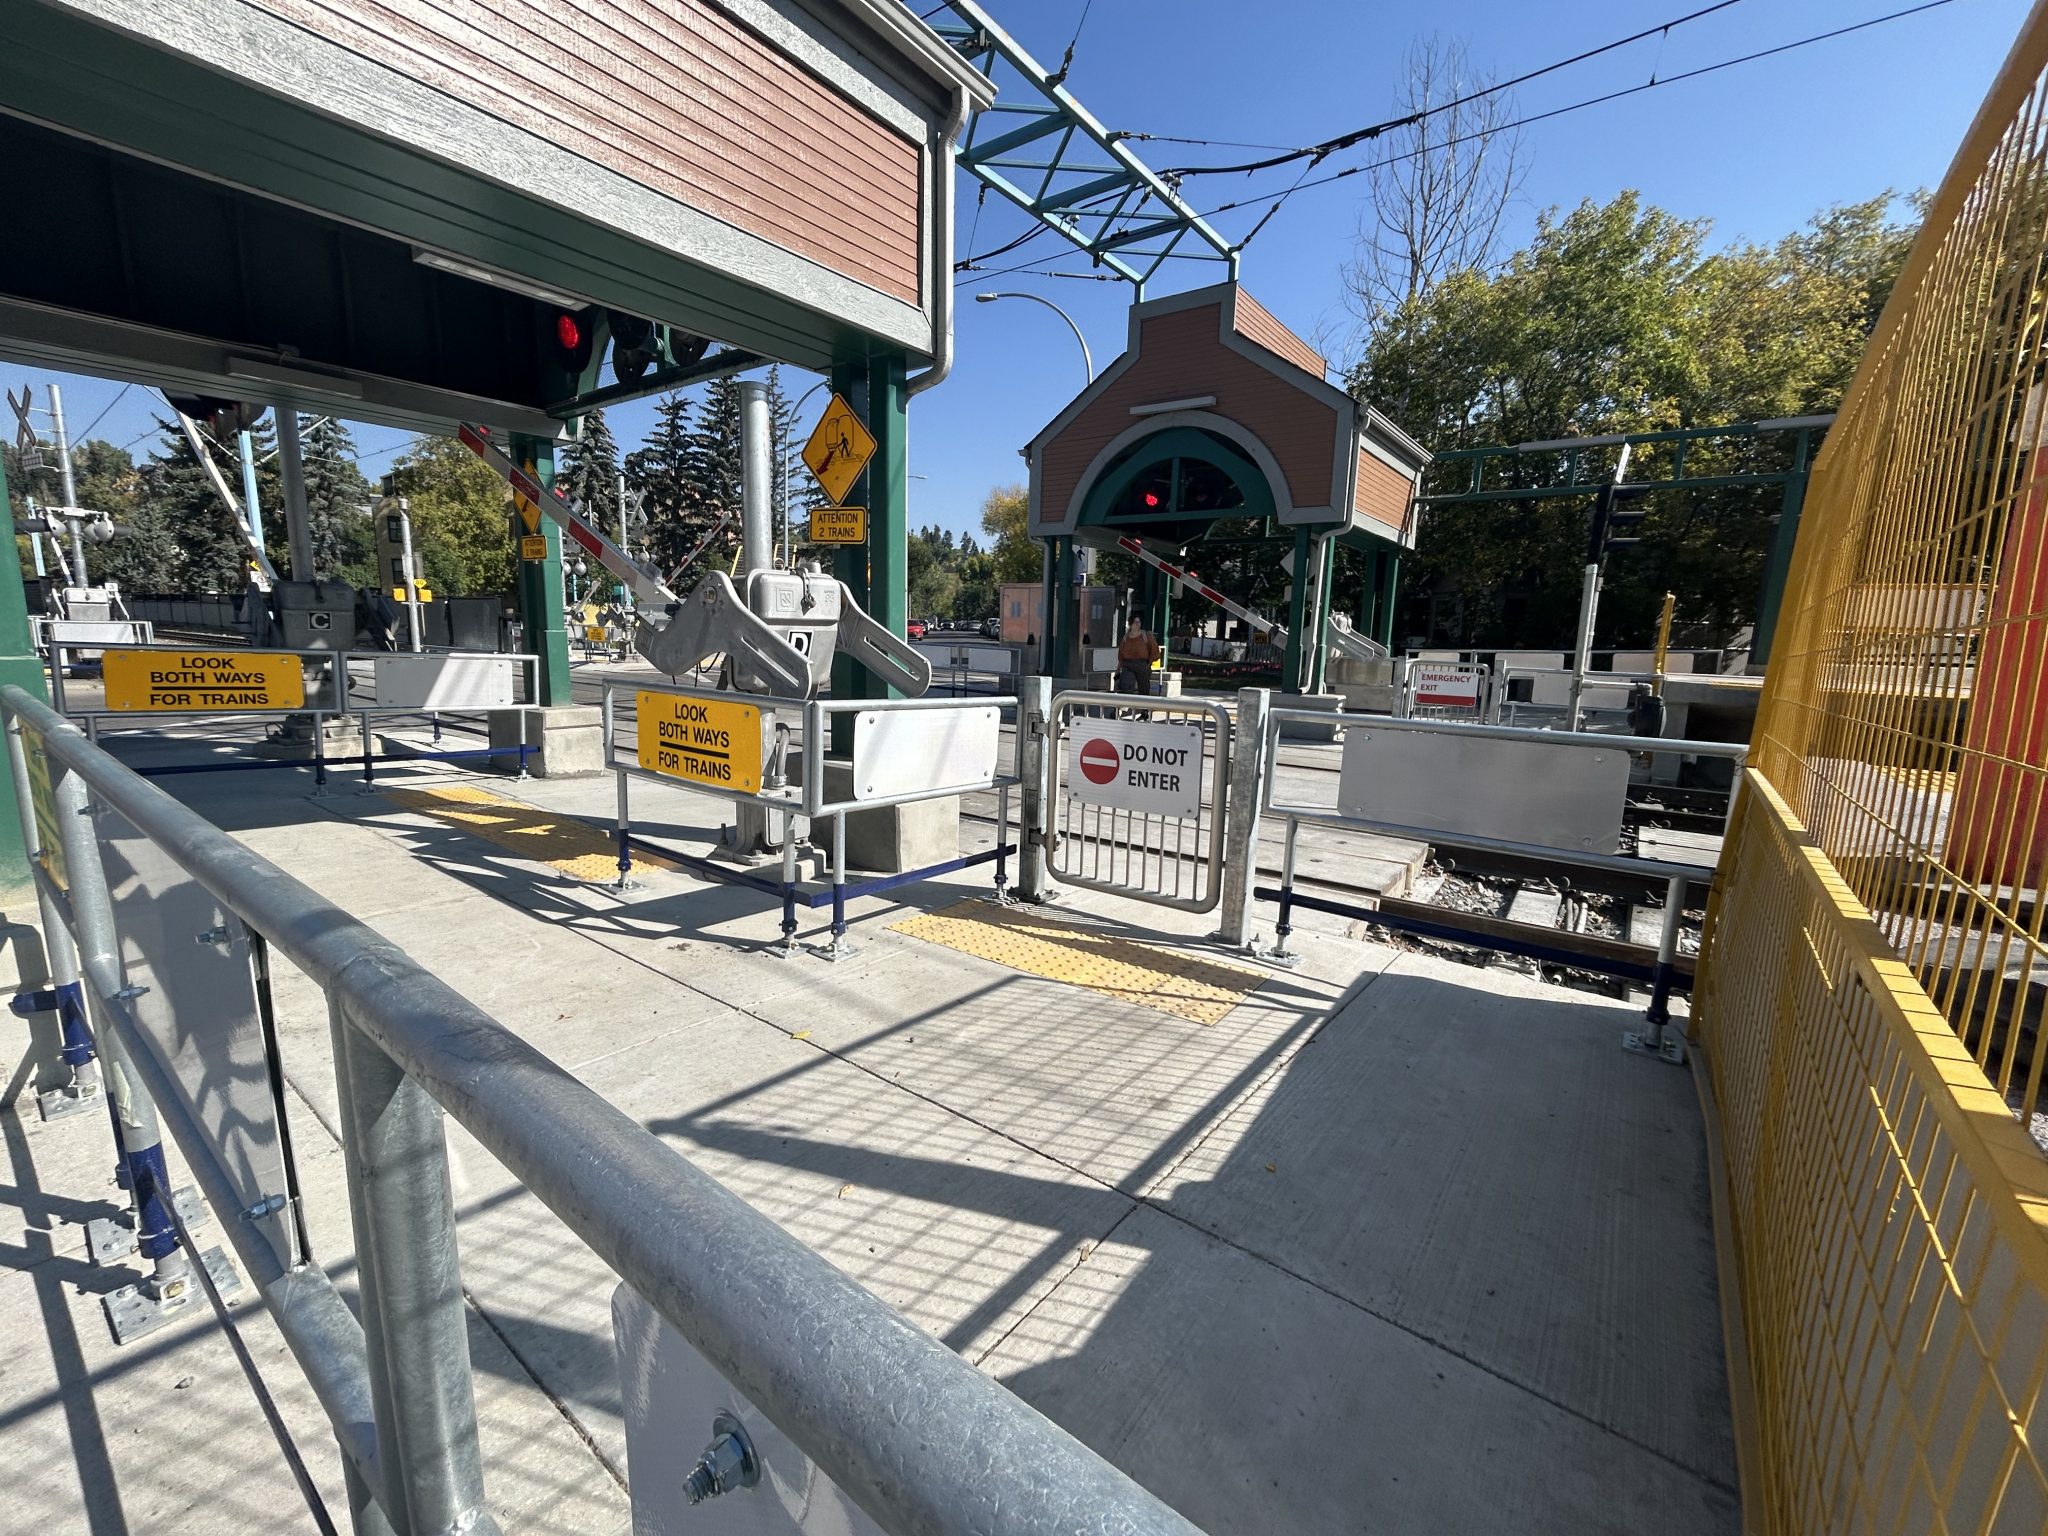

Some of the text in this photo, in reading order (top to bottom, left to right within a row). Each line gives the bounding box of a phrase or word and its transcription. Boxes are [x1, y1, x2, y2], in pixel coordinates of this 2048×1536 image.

[817, 513, 858, 523] ATTENTION
[819, 527, 855, 538] 2 TRAINS
[311, 613, 329, 629] C
[790, 632, 809, 656] D
[181, 657, 235, 669] LOOK
[150, 672, 266, 684] BOTH WAYS
[1421, 673, 1471, 683] EMERGENCY
[150, 693, 269, 705] FOR TRAINS
[674, 702, 708, 723] LOOK
[659, 721, 730, 748] BOTH WAYS
[1123, 744, 1188, 767] DO NOT
[659, 751, 731, 780] FOR TRAINS
[1128, 770, 1180, 792] ENTER
